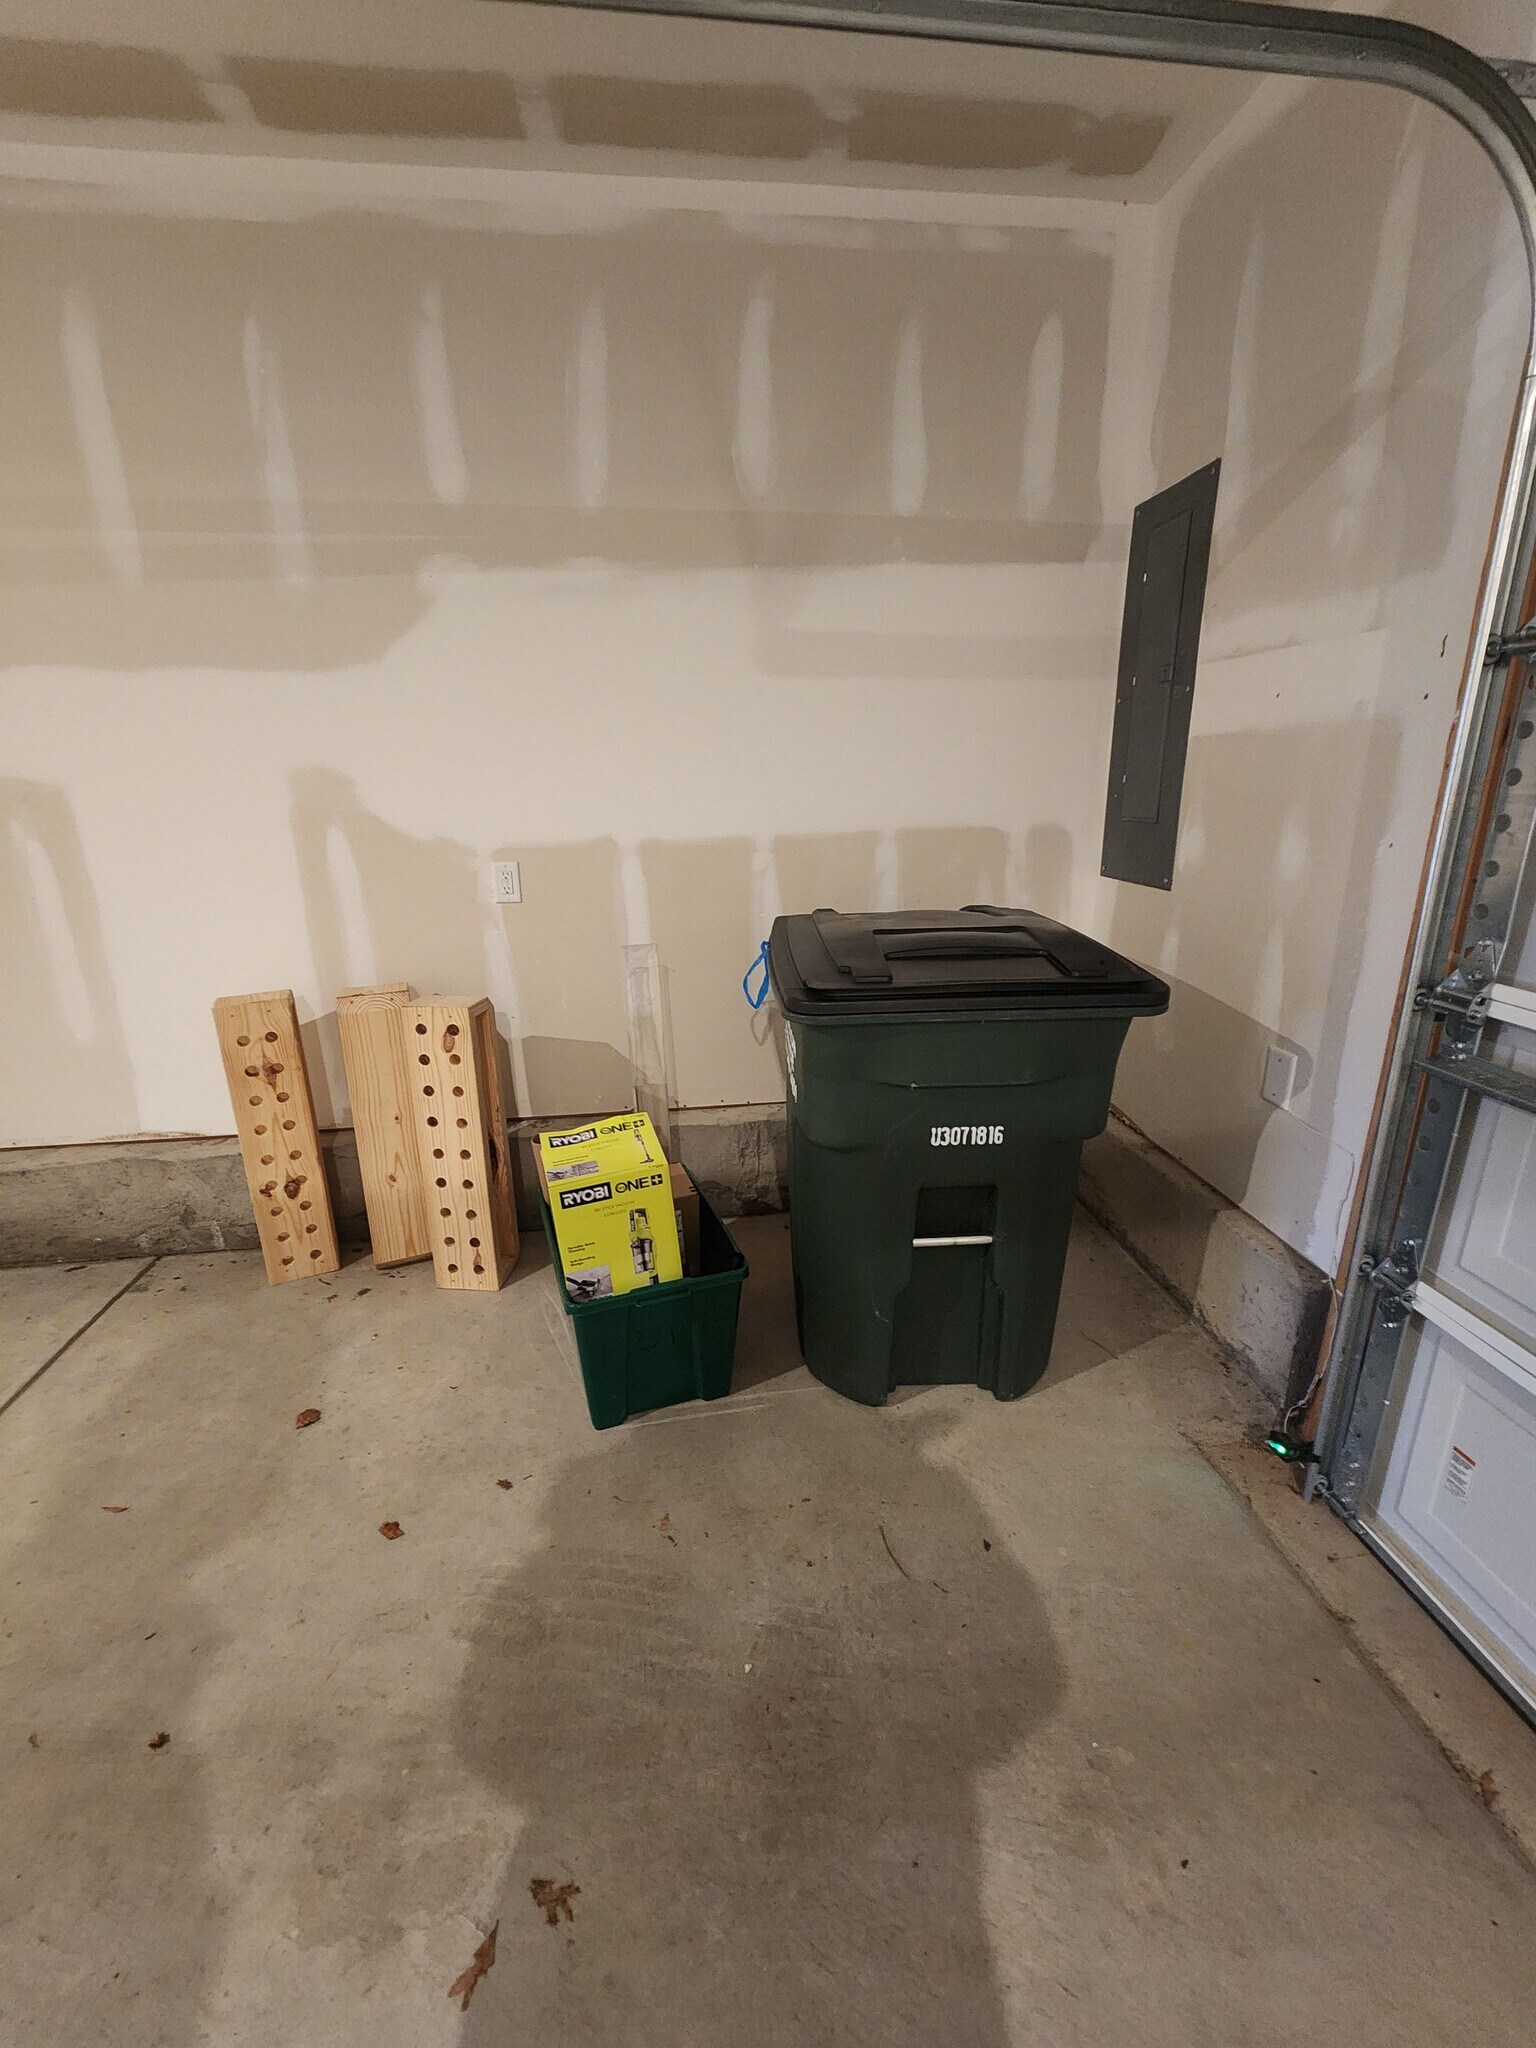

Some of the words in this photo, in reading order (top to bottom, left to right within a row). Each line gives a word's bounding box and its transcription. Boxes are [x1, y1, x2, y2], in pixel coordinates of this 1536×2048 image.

[550, 1130, 595, 1147] RYOBI
[930, 1126, 1004, 1147] U3071816
[562, 1185, 610, 1206] RYOBI
